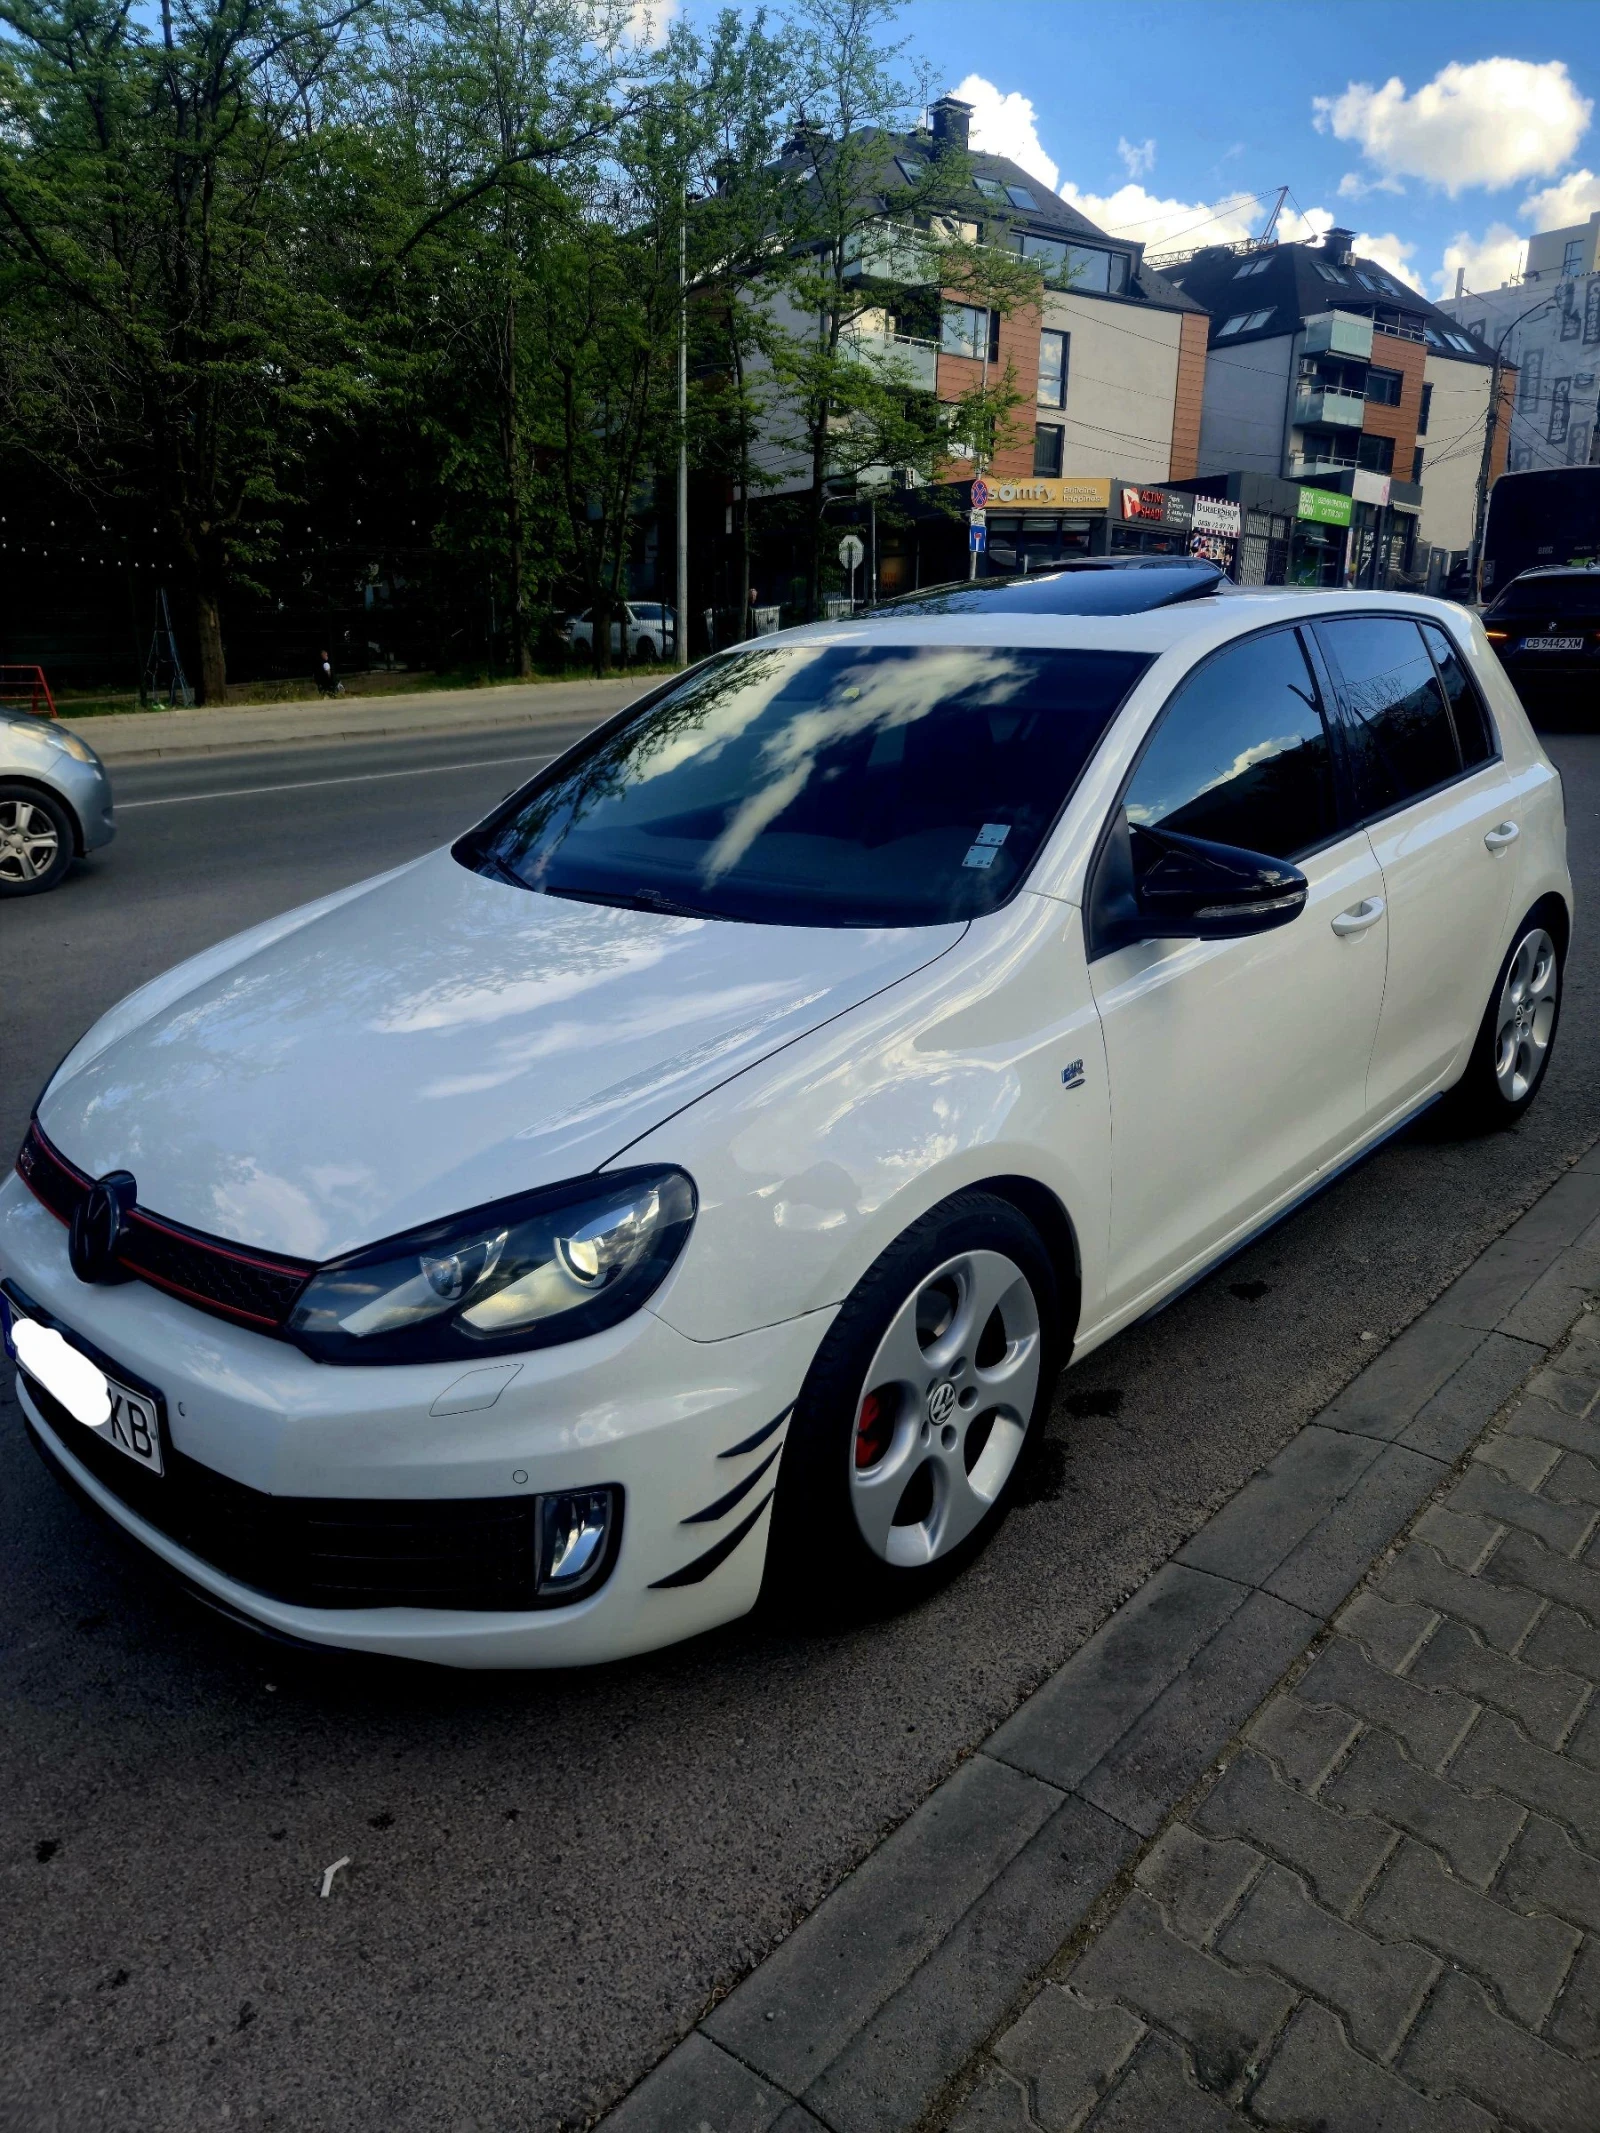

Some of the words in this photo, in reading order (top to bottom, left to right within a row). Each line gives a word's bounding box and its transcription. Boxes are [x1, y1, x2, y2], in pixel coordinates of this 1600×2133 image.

[987, 482, 1053, 503] somfy
[1063, 486, 1097, 495] Building
[1141, 490, 1164, 504] ACTIVE
[1300, 490, 1314, 504] BOX
[1141, 506, 1163, 521] SHADE
[1299, 502, 1314, 517] NOW
[1526, 638, 1540, 649] CB
[1541, 638, 1567, 649] 9442
[1567, 638, 1582, 649] XM
[107, 1386, 153, 1459] KB
